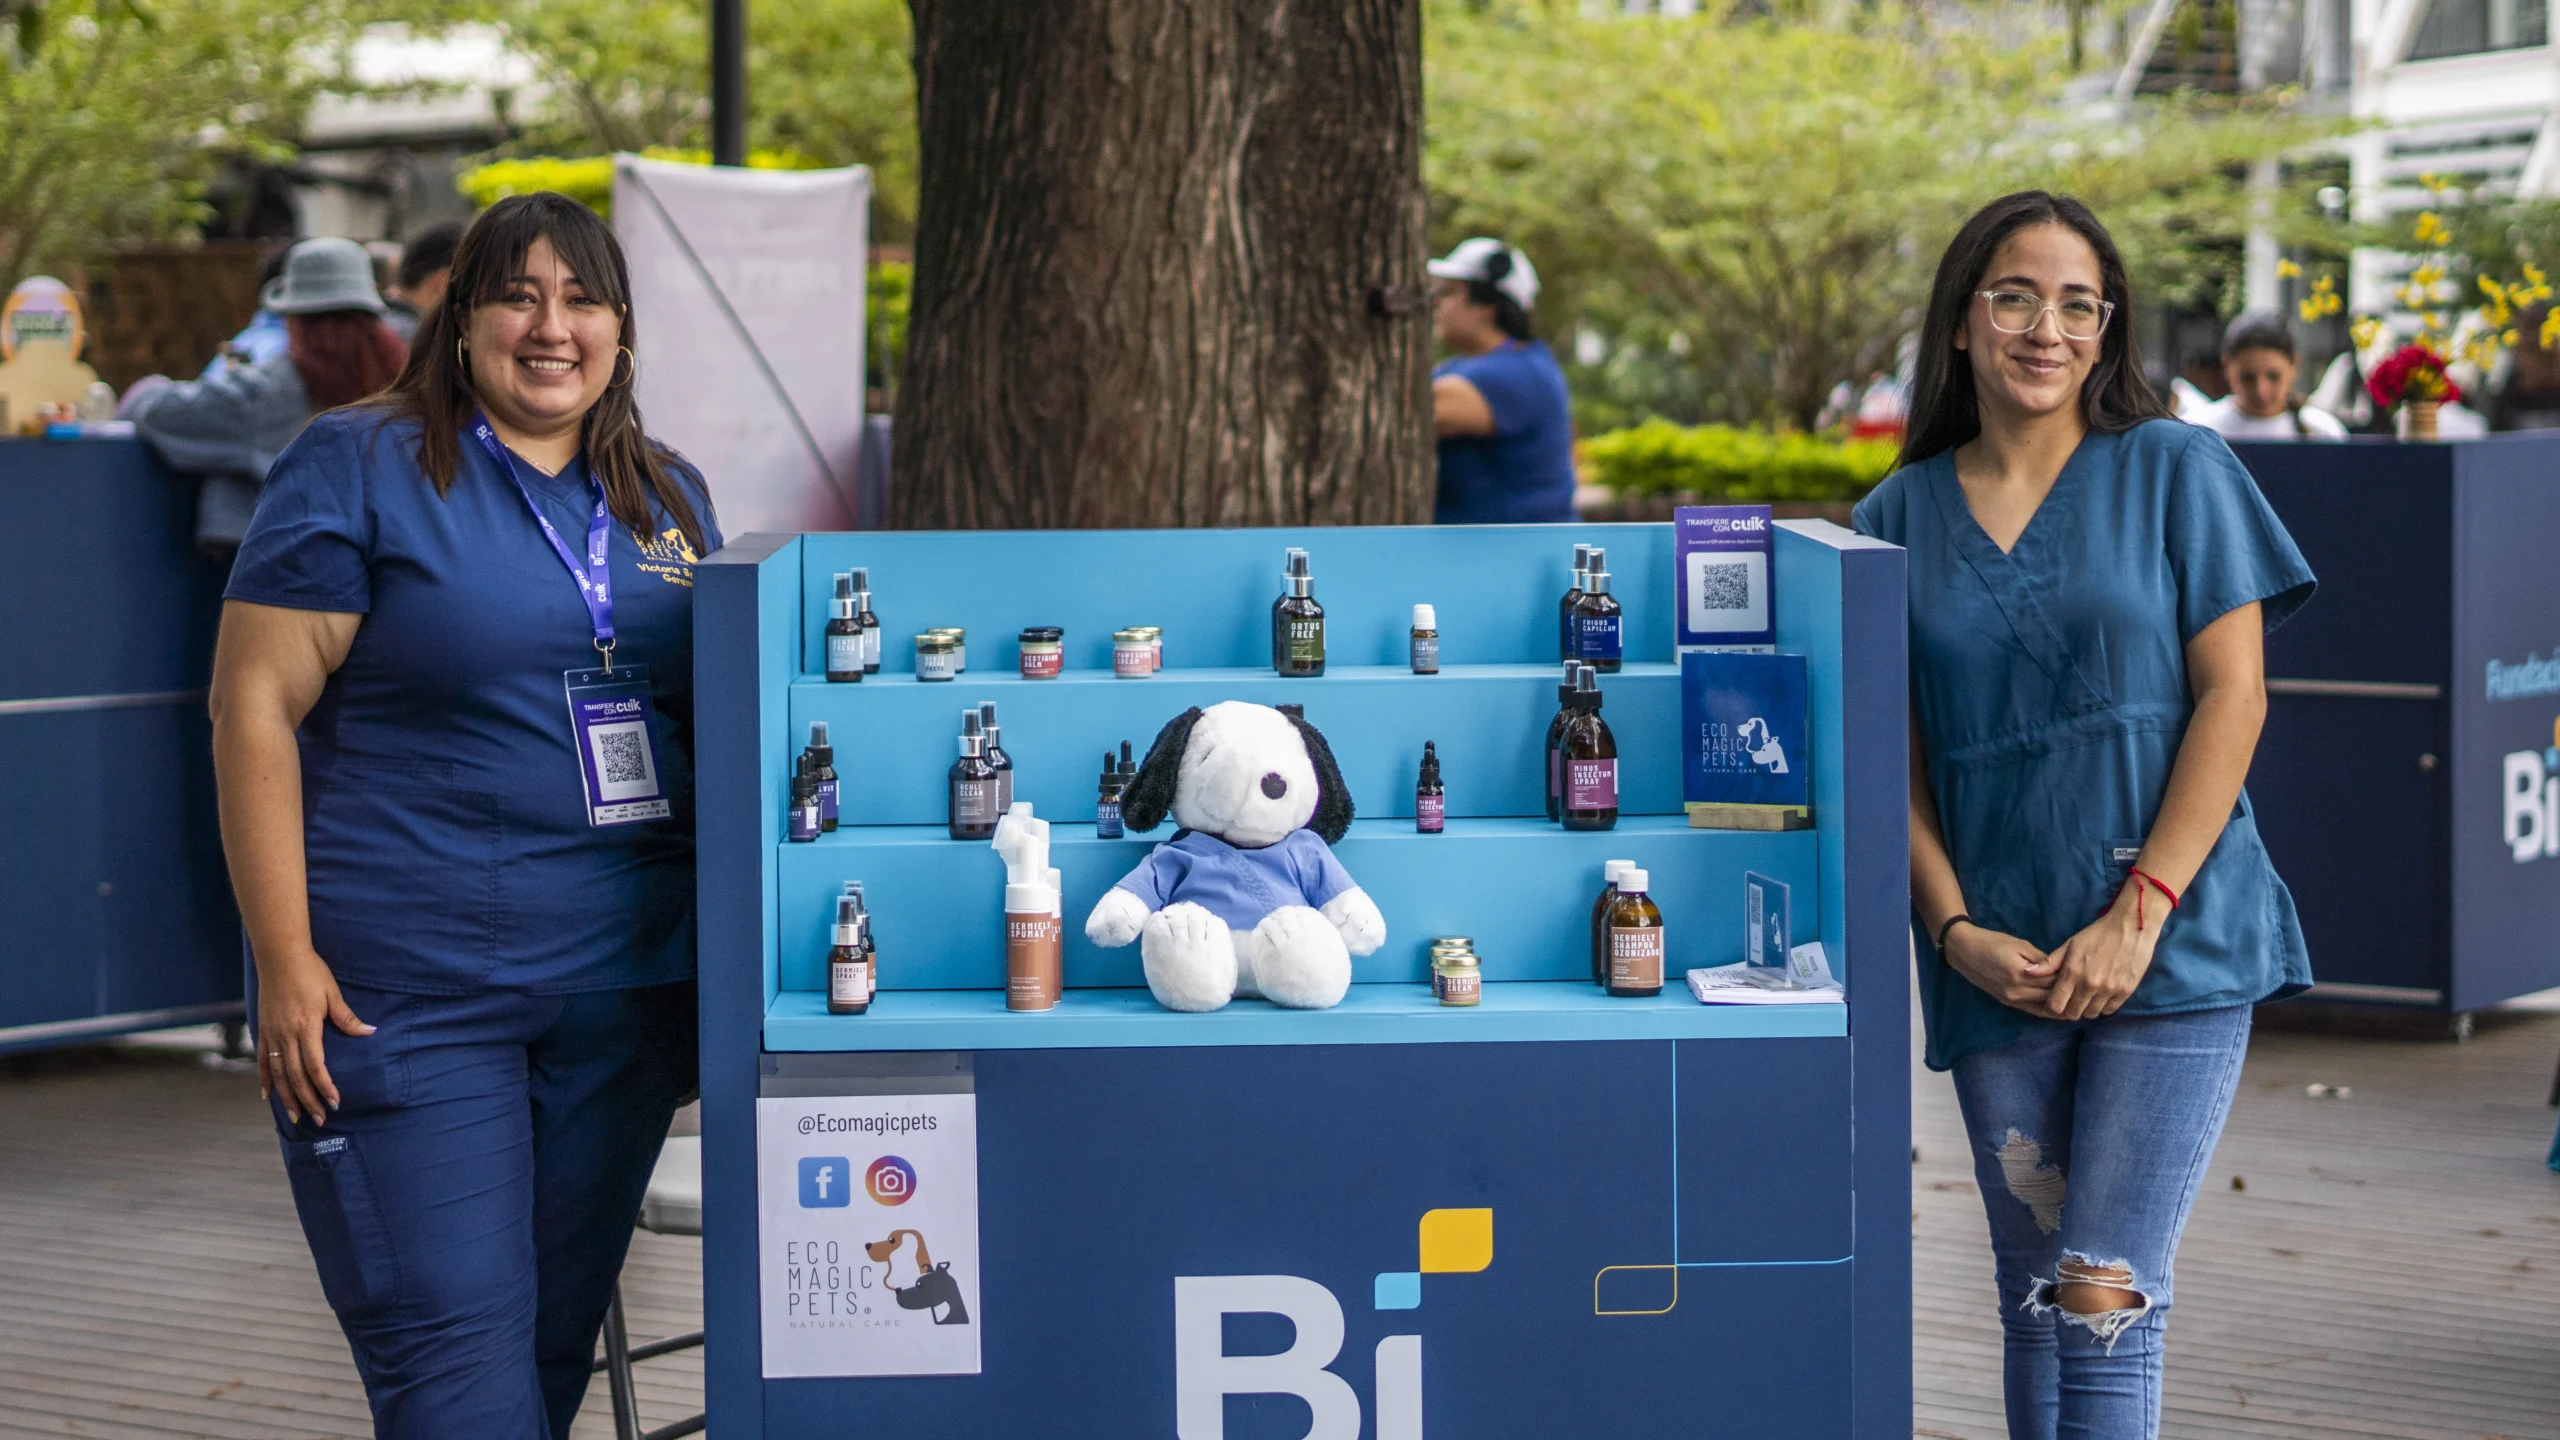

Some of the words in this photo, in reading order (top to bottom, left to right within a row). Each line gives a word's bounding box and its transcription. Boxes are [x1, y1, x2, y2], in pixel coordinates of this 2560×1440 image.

[1686, 518, 1730, 526] TRANSFIERE
[636, 562, 680, 575] Victoria
[1291, 622, 1320, 631] ORTUS
[1291, 630, 1314, 639] FREE
[584, 702, 616, 711] TRANSFIERE
[1702, 723, 1727, 737] ECO
[1702, 738, 1743, 751] MAGIC
[1614, 933, 1656, 942] DERMIELY
[1614, 941, 1654, 949] SHAMPOO
[1447, 984, 1473, 992] CREAM
[797, 1111, 938, 1136] @Ecomagicpets
[787, 1240, 840, 1265] ECO
[788, 1265, 873, 1290] MAGIC
[789, 1320, 855, 1329] NATURAL
[864, 1319, 901, 1328] CARE
[1174, 1271, 1424, 1440] Bi
